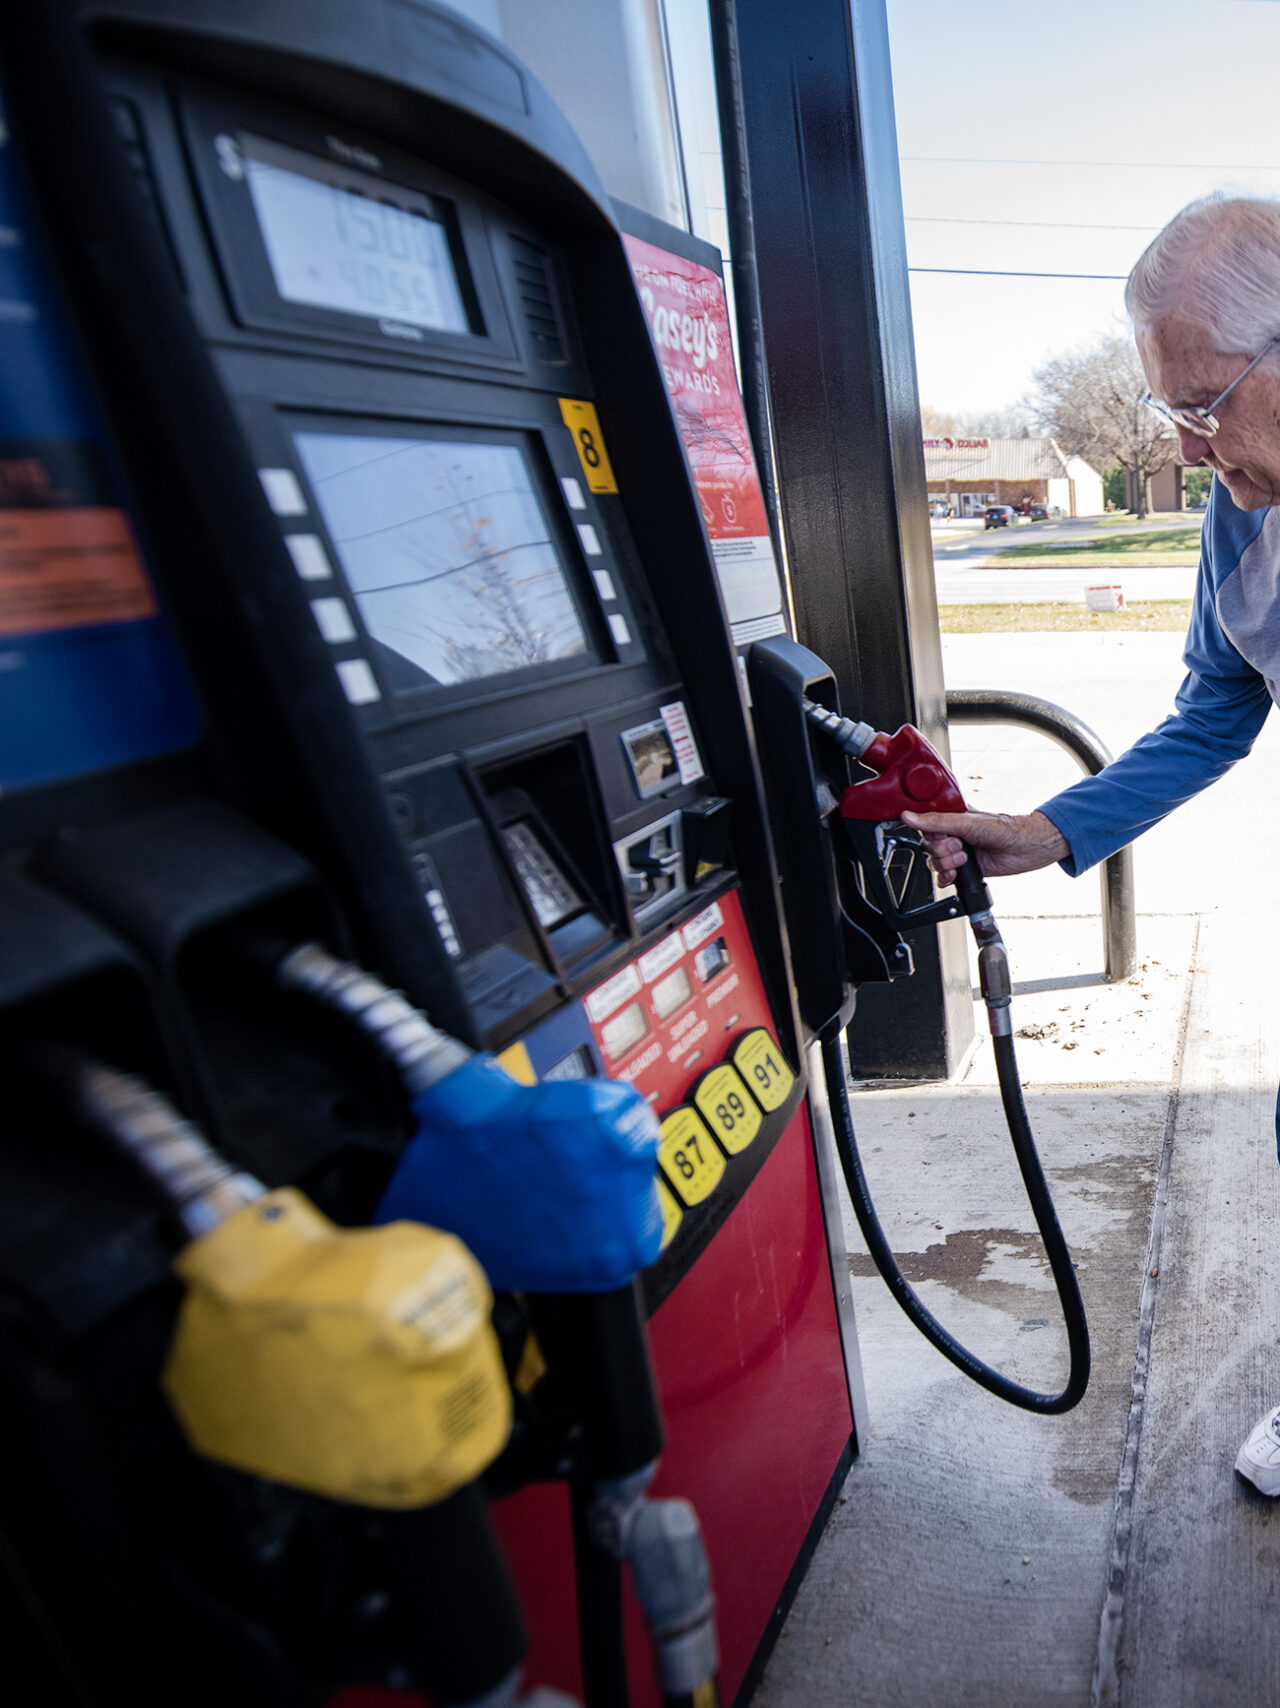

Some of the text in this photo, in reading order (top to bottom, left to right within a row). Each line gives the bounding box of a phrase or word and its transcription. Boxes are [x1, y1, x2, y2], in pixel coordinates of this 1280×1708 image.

[664, 365, 721, 396] EWARDS
[580, 428, 600, 468] 8
[957, 439, 988, 448] DOLLAR
[667, 1019, 710, 1063] UNLEADED
[669, 1010, 698, 1041] SUPER
[754, 1053, 781, 1089] 91
[716, 1092, 745, 1131] 89
[674, 1134, 705, 1179] 87
